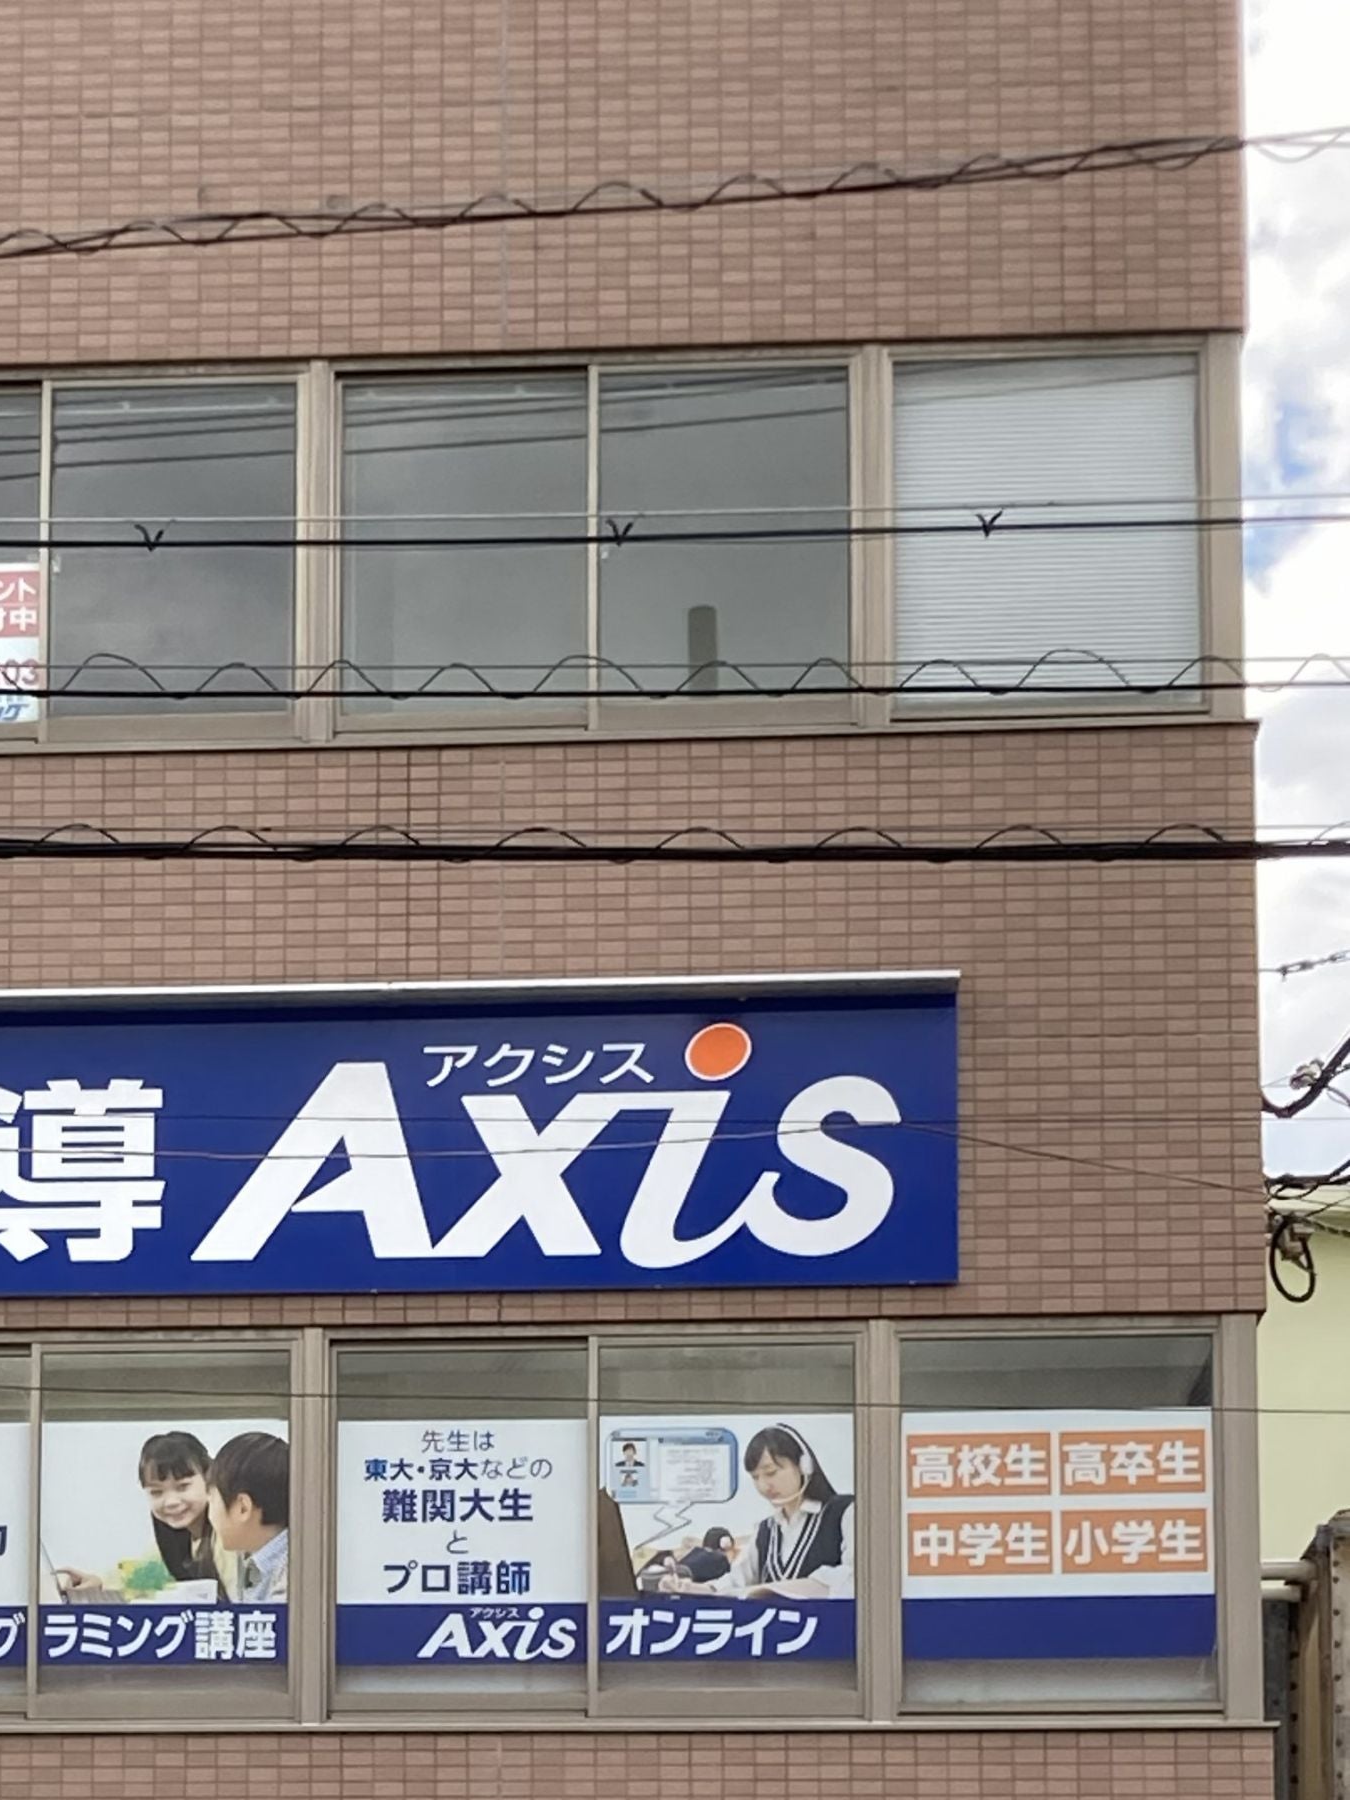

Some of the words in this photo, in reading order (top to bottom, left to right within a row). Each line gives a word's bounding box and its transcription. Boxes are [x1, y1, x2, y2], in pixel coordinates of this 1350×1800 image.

[423, 1042, 654, 1087] アクシス
[191, 1022, 901, 1268] Axis
[420, 1429, 495, 1453] 先生は
[364, 1458, 552, 1482] 東大・京大などの
[910, 1443, 1048, 1489] 高校生
[1062, 1440, 1202, 1486] 高卒生
[382, 1488, 534, 1524] 難関大生
[445, 1529, 469, 1556] と
[912, 1522, 1050, 1567] 中学生
[1064, 1519, 1204, 1565] 小学生
[383, 1560, 532, 1597] プロ講師
[470, 1607, 520, 1619] アクシス
[416, 1606, 578, 1661] Axis
[605, 1608, 819, 1657] オンライン
